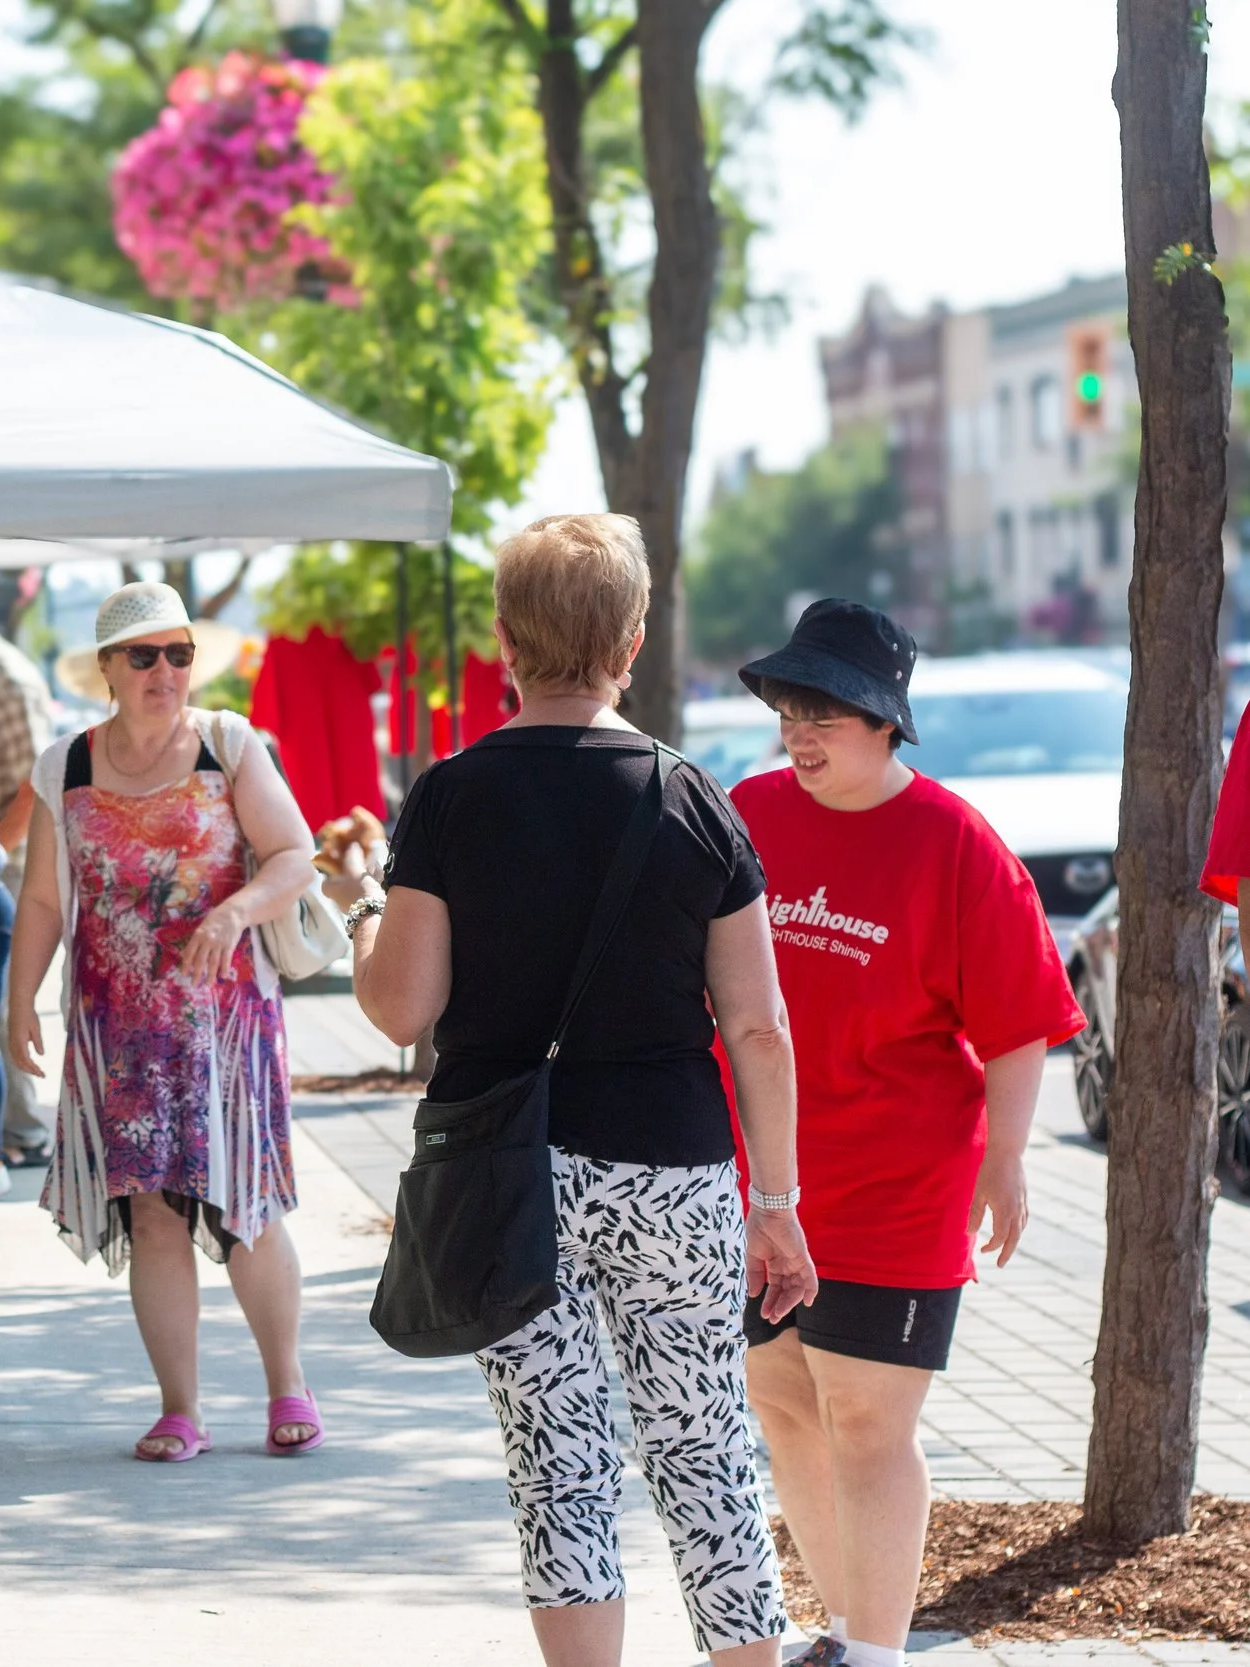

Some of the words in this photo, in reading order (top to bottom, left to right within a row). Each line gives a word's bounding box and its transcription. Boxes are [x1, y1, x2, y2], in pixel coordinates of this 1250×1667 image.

[765, 886, 889, 944] ighthouse
[830, 939, 871, 967] Shining
[902, 1299, 918, 1342] HEAD
